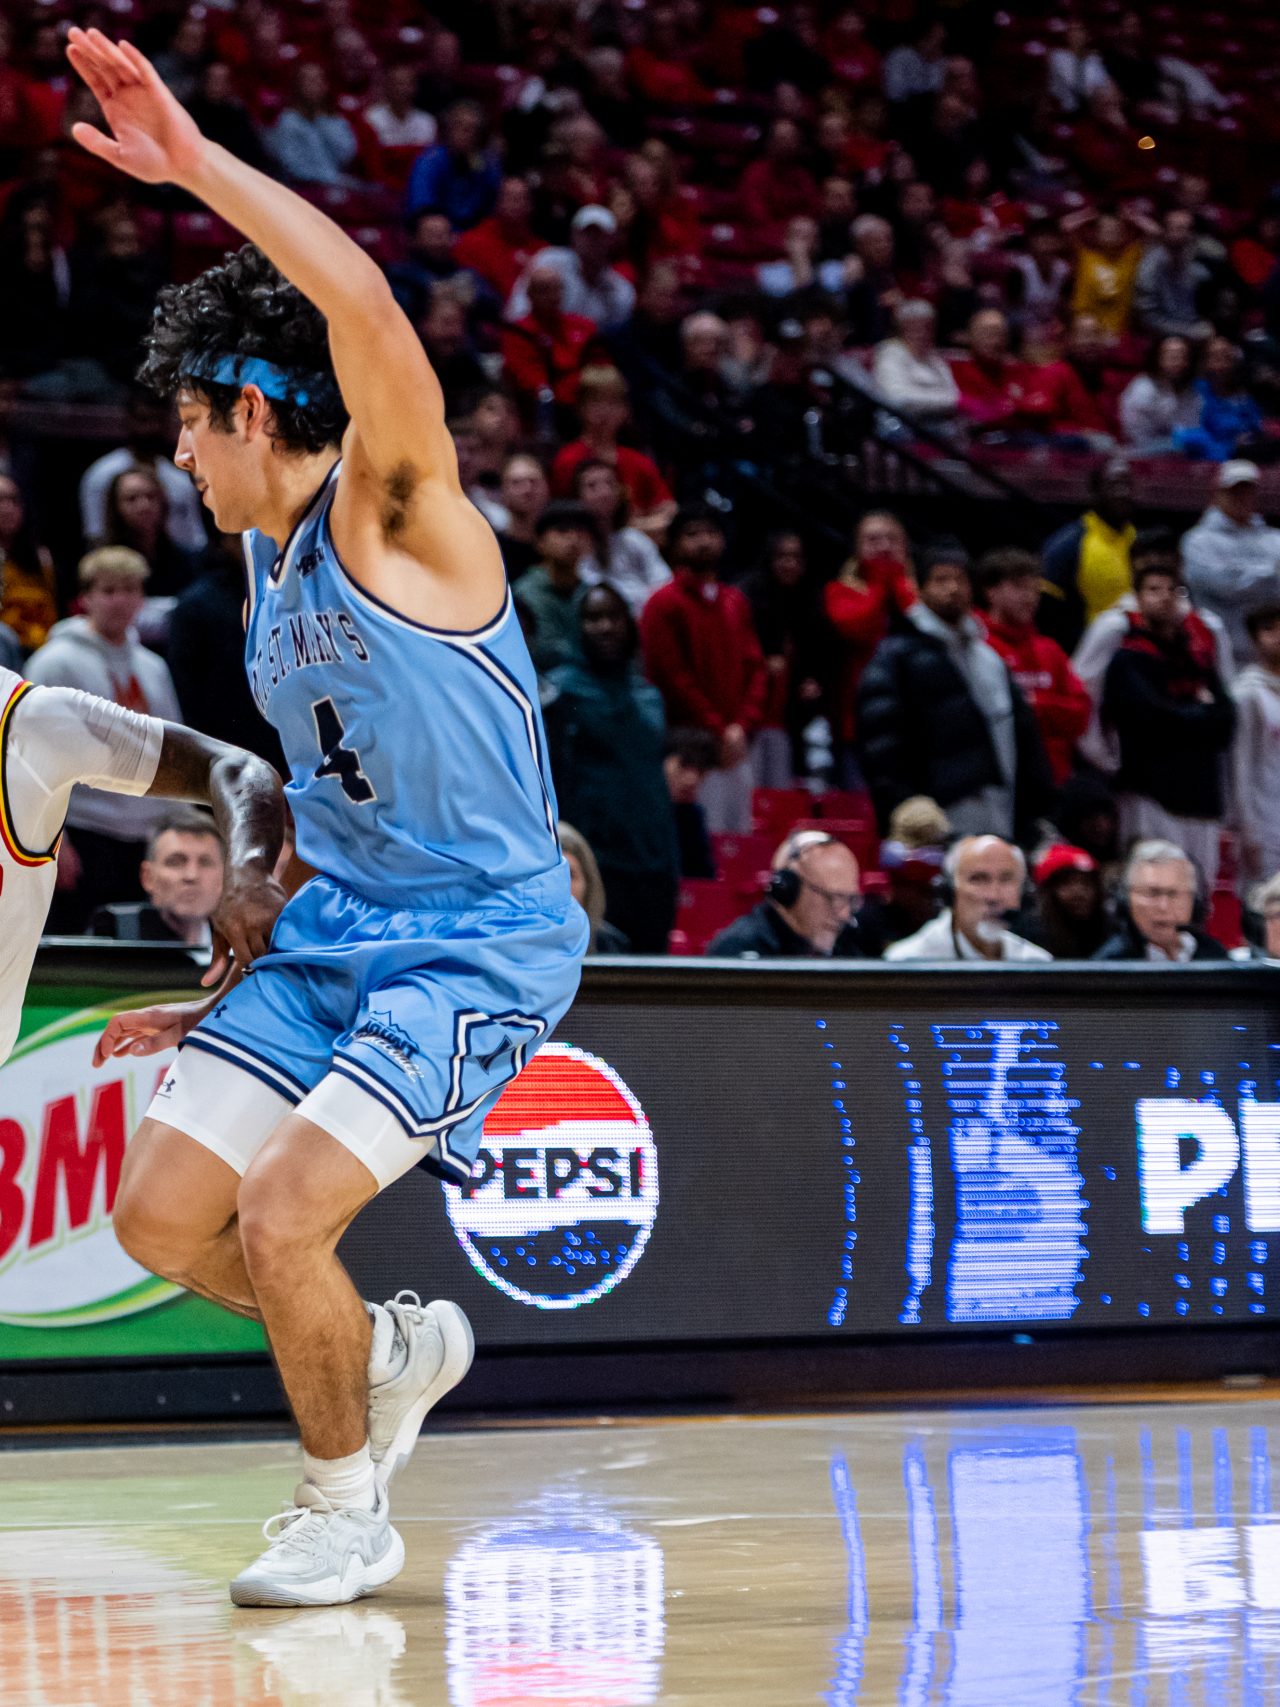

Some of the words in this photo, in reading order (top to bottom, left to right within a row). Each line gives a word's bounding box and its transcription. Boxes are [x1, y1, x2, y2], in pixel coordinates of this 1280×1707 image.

[267, 624, 292, 687] ST.
[310, 695, 378, 805] 4
[461, 1147, 642, 1199] PEPSI
